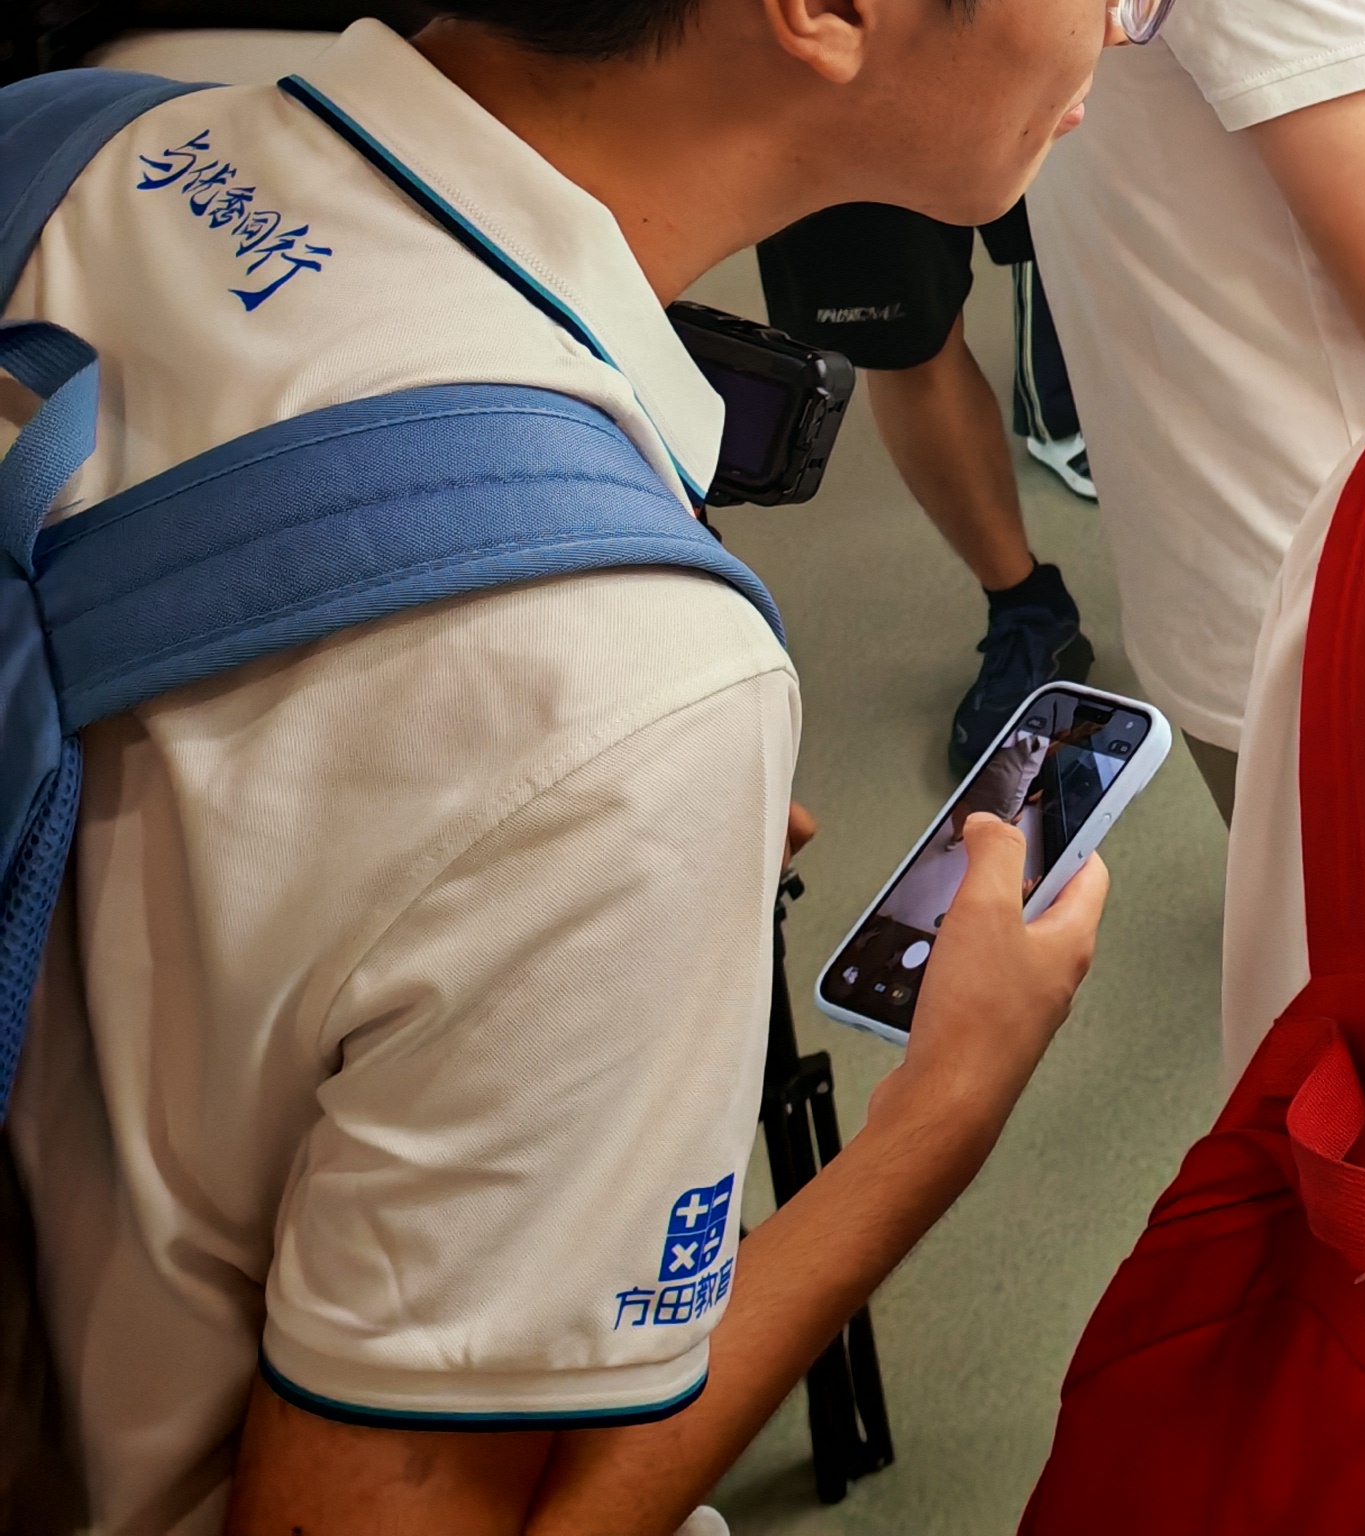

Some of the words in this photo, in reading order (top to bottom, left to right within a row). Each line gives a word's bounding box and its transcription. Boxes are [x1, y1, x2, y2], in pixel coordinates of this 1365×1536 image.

[135, 127, 334, 313] 与优秀同行
[612, 1256, 736, 1331] 方田教育
